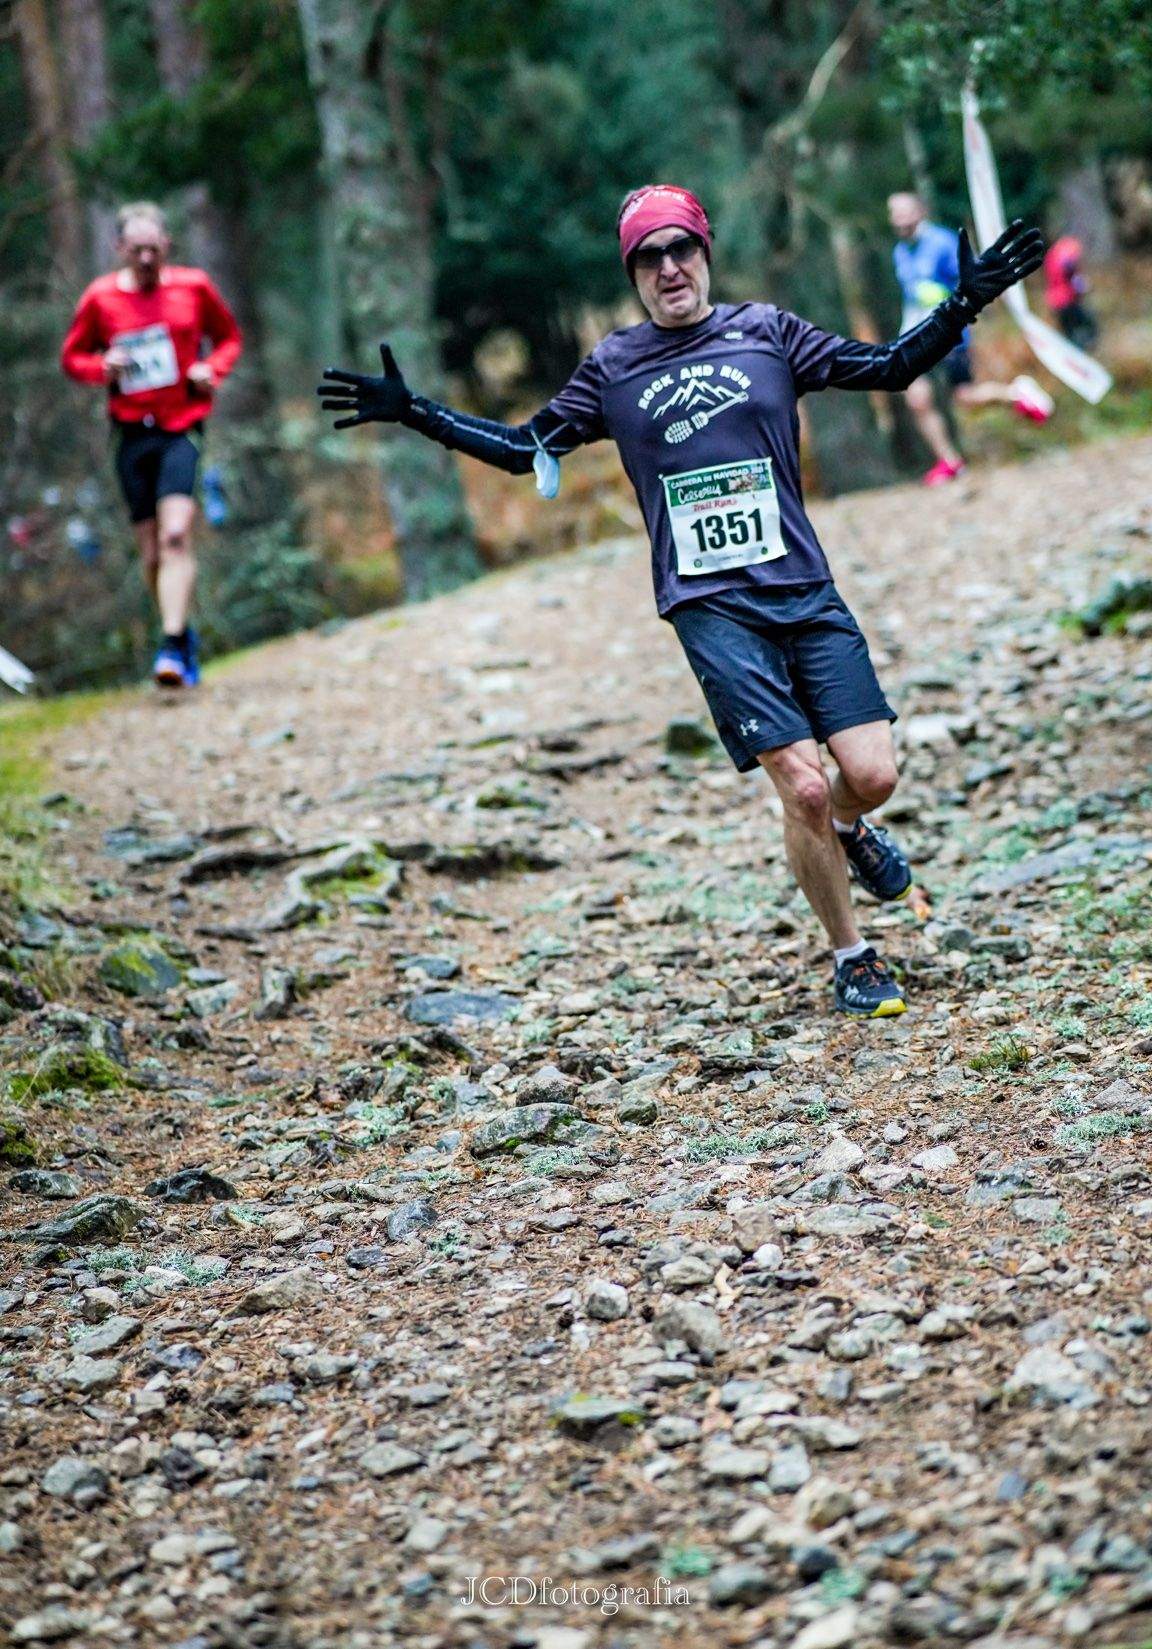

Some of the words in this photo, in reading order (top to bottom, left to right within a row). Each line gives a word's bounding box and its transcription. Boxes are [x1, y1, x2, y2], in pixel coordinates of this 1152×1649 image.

[638, 373, 675, 410] ROCK
[680, 364, 715, 381] AND
[720, 365, 752, 390] RUN
[713, 467, 749, 481] NAVIDAD
[690, 508, 764, 552] 1351
